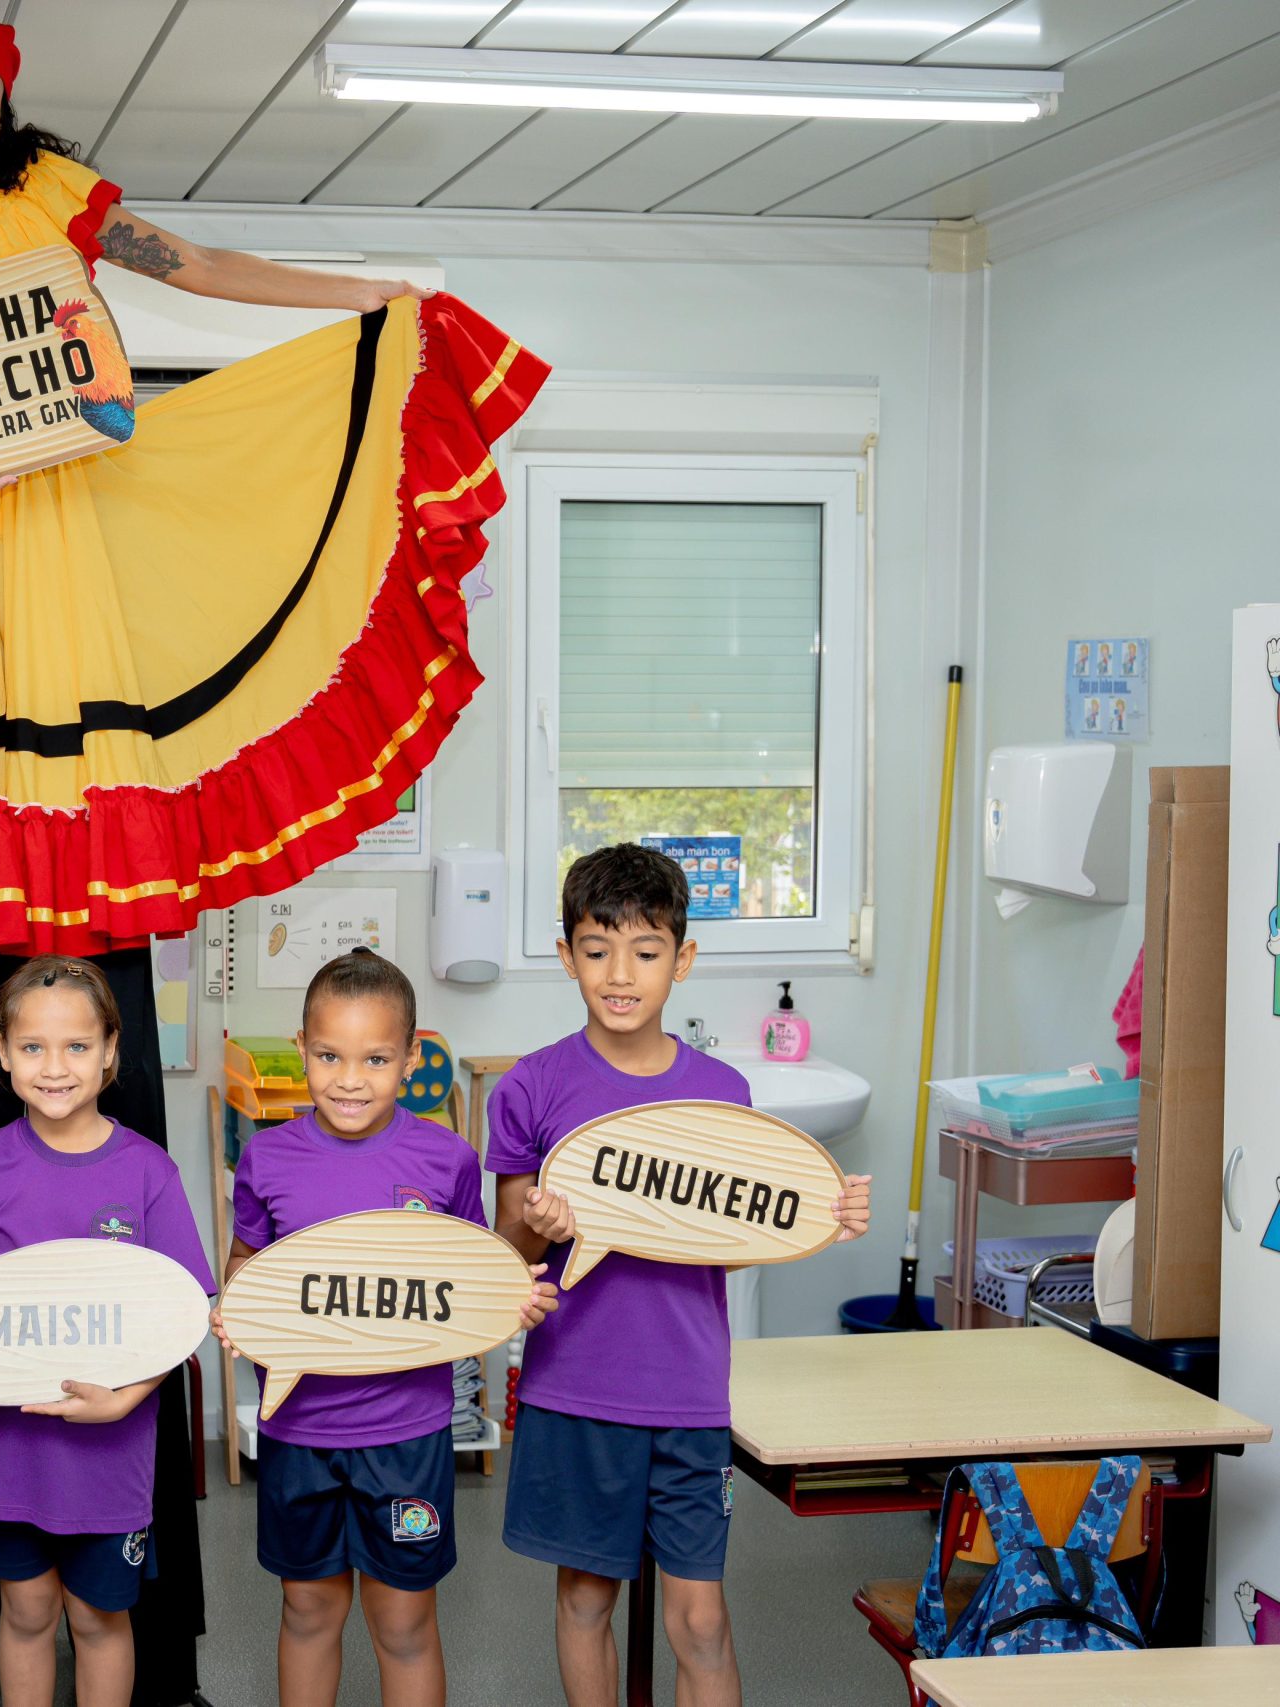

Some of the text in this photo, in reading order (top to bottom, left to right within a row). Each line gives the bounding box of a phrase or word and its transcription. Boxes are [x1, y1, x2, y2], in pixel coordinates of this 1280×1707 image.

[40, 395, 81, 426] GAY
[687, 848, 709, 856] man
[712, 847, 730, 856] bon
[338, 921, 353, 929] cas
[337, 938, 362, 946] come
[592, 1145, 800, 1231] CUNUKERO
[300, 1273, 455, 1322] CALBAS
